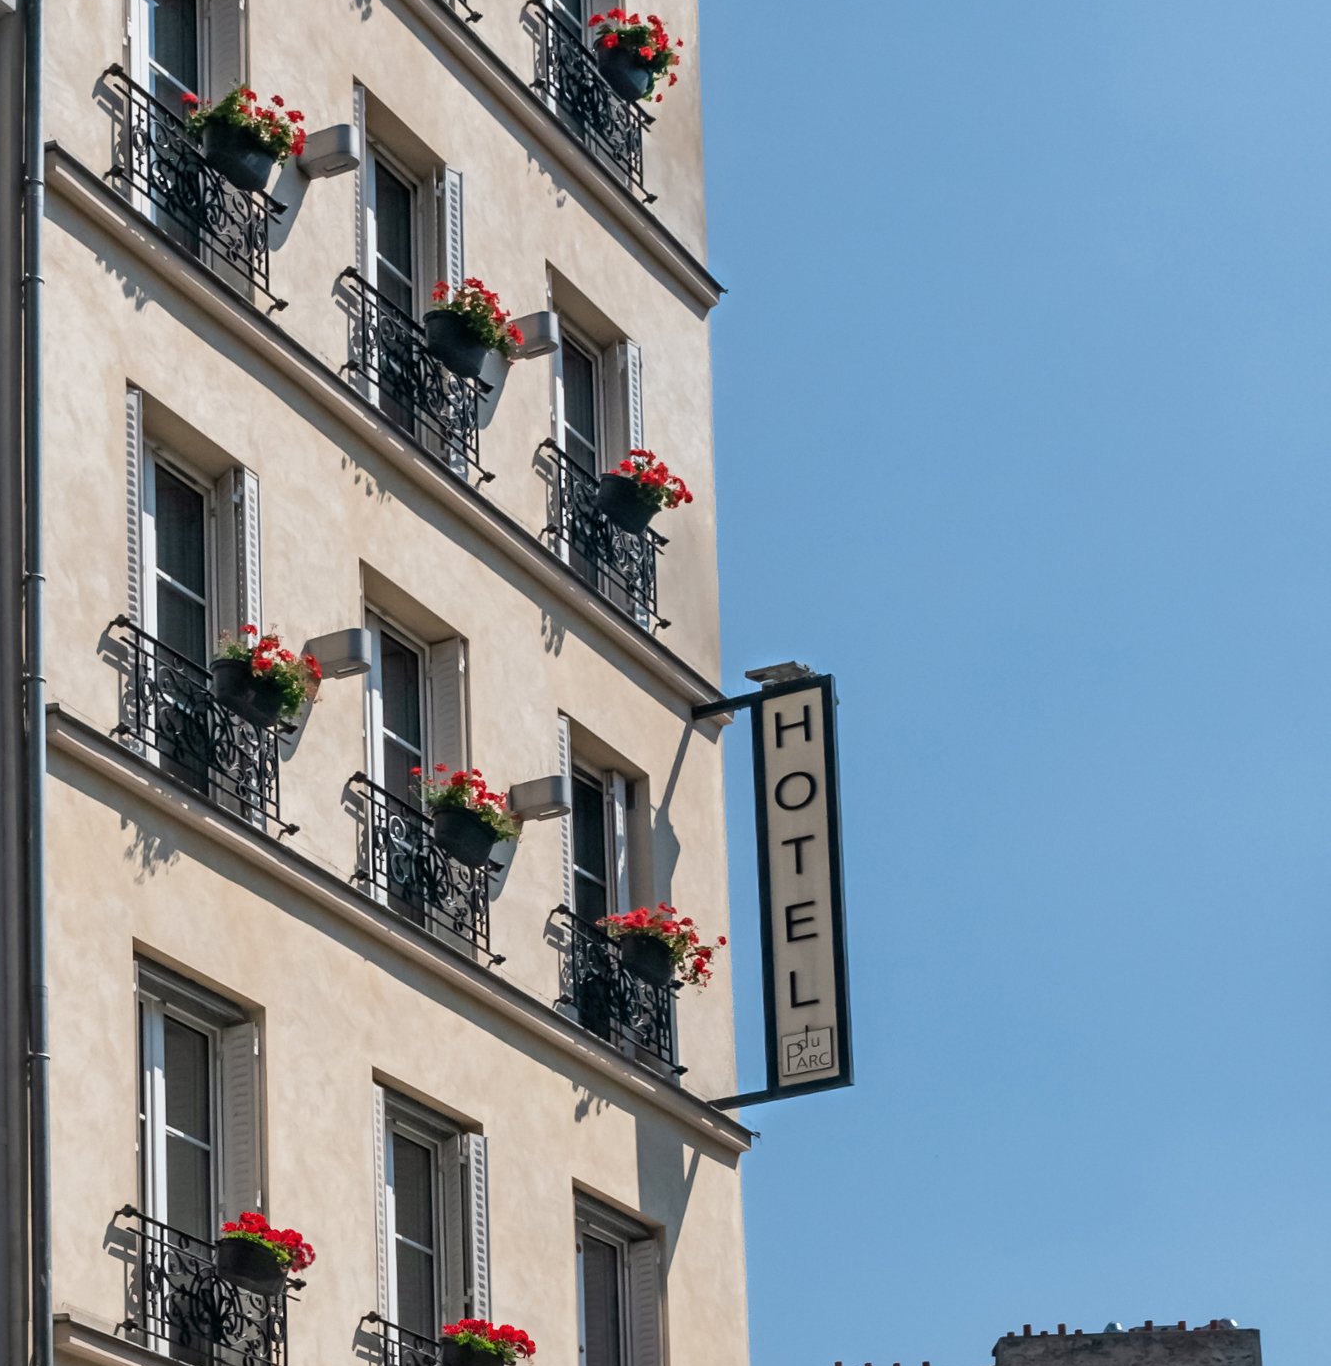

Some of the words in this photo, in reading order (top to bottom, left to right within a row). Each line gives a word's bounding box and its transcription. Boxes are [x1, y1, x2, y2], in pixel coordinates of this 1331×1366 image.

[773, 704, 820, 1010] HOTEL
[797, 1025, 820, 1049] du
[787, 1042, 830, 1072] PARC
